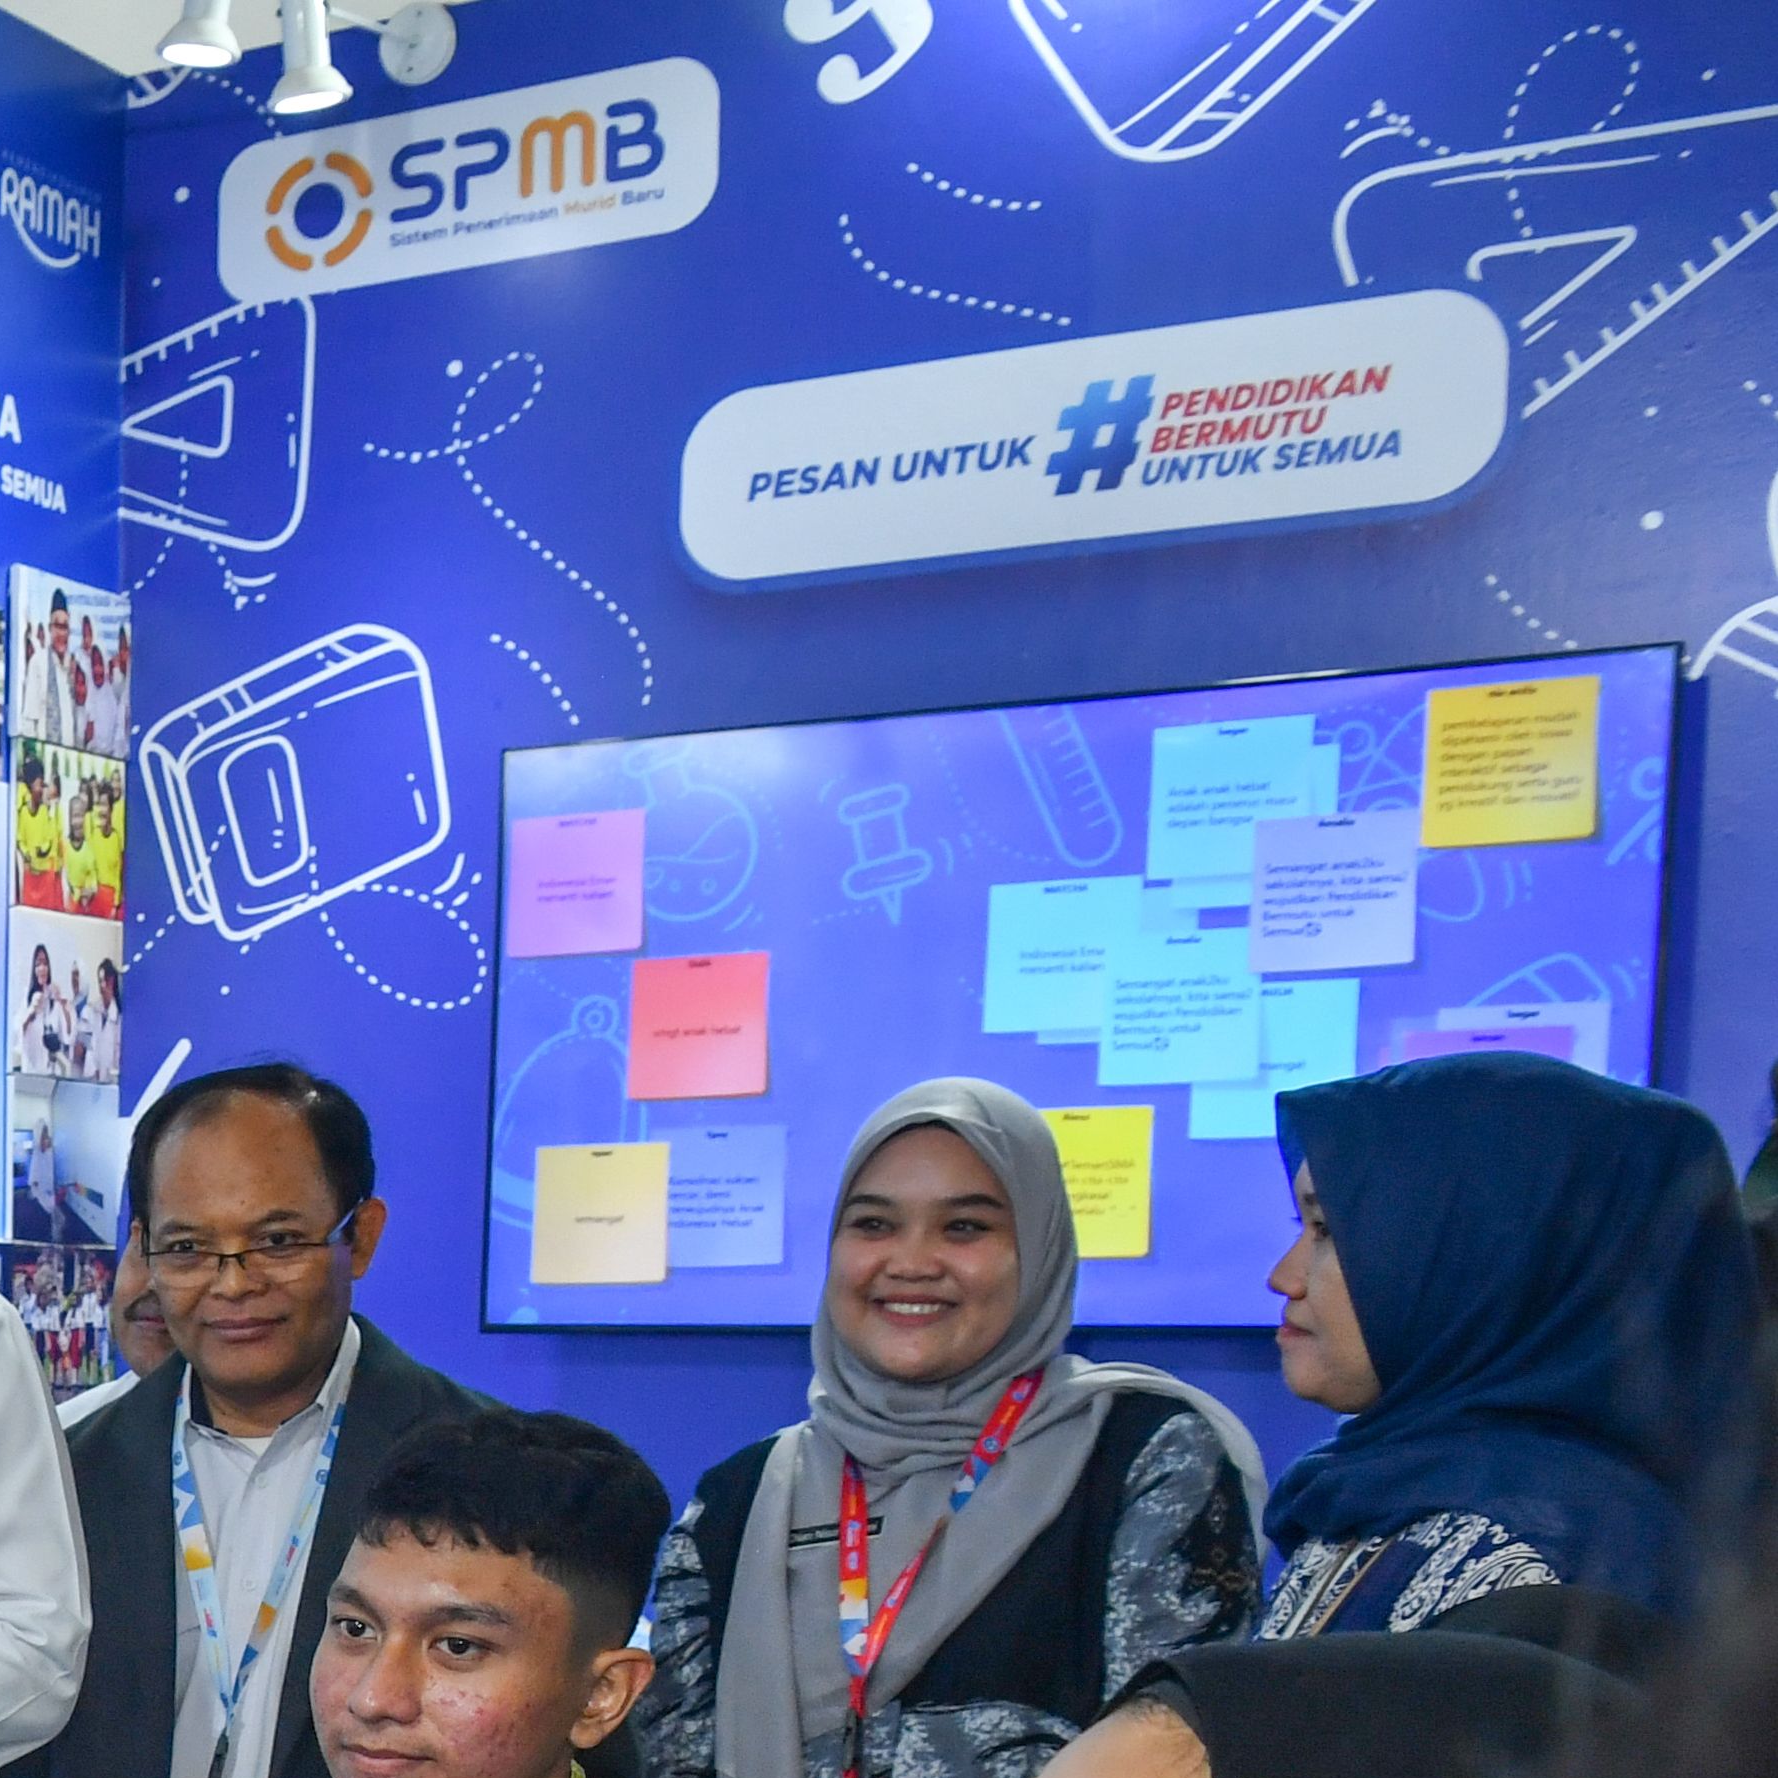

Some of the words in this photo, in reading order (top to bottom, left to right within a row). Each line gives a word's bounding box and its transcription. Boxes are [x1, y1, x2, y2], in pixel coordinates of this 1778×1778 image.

[390, 98, 665, 222] SPMB
[0, 167, 101, 262] RAMAH
[390, 227, 448, 247] Sistem
[453, 208, 559, 236] Penerimaan
[564, 195, 616, 215] Murid
[621, 188, 664, 207] Baru
[745, 457, 881, 502] PESAN
[890, 435, 1037, 483] UNTUK
[1158, 364, 1392, 420] PENDIDIKAN
[1139, 441, 1263, 486] UNTUK
[1271, 429, 1401, 470] SEMUA
[1149, 406, 1328, 455] BERMUTU
[2, 464, 66, 514] SEMUA
